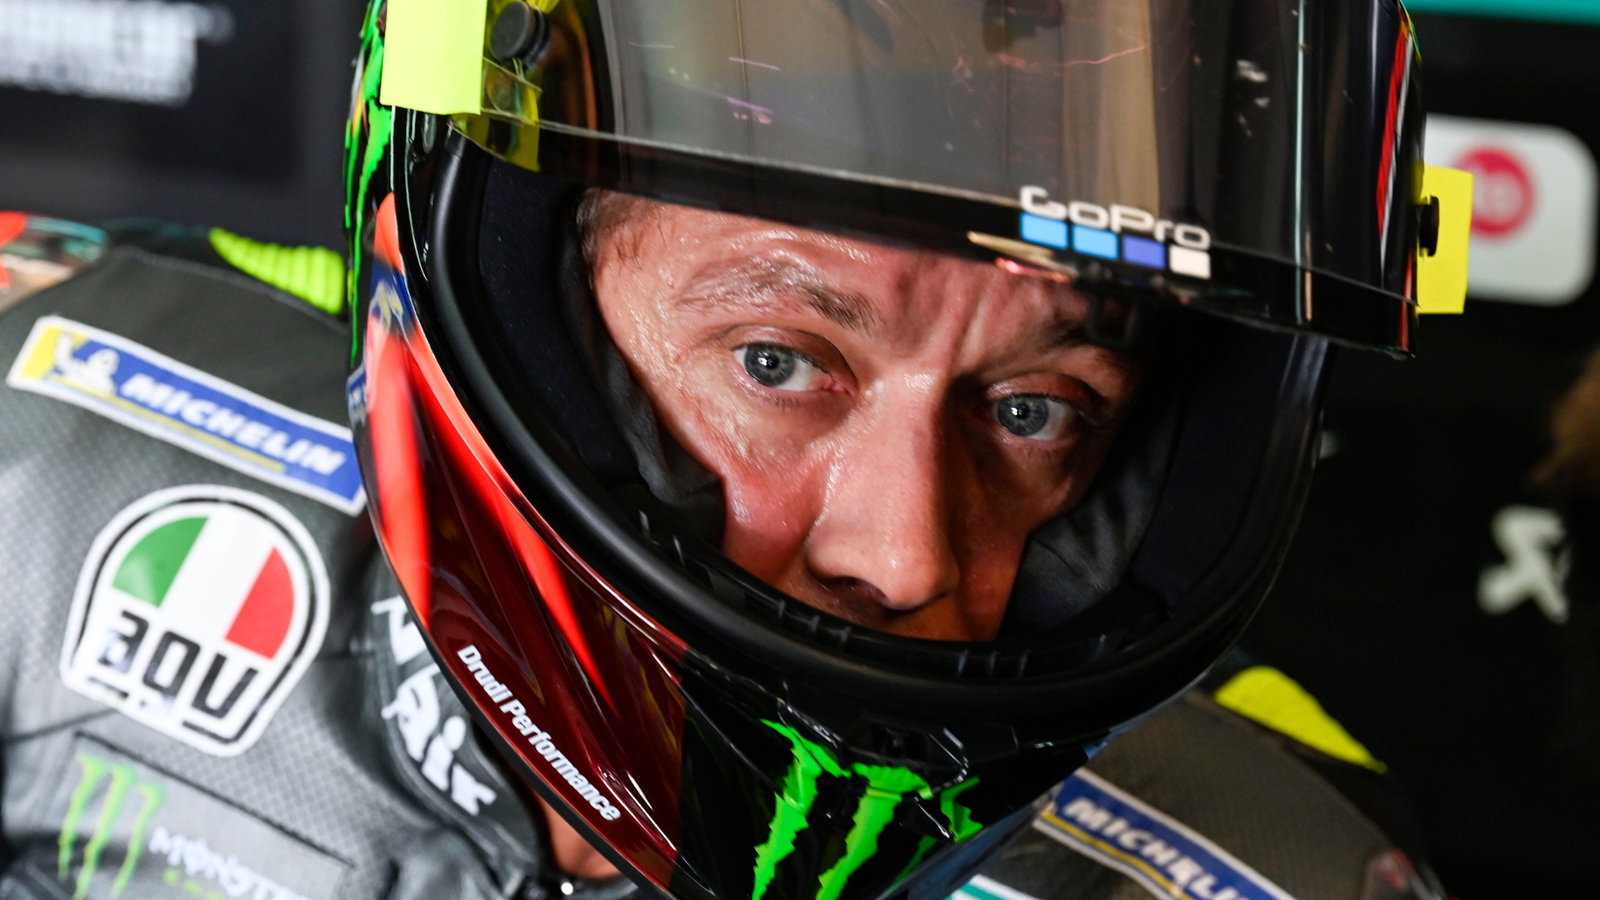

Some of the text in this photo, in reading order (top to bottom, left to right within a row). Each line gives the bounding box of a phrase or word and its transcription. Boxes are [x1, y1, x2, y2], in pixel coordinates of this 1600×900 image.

[1019, 184, 1212, 250] GoPro
[119, 372, 347, 476] MICHELIN
[457, 644, 622, 821] Drudi Performance
[1062, 796, 1252, 900] MICHELI
